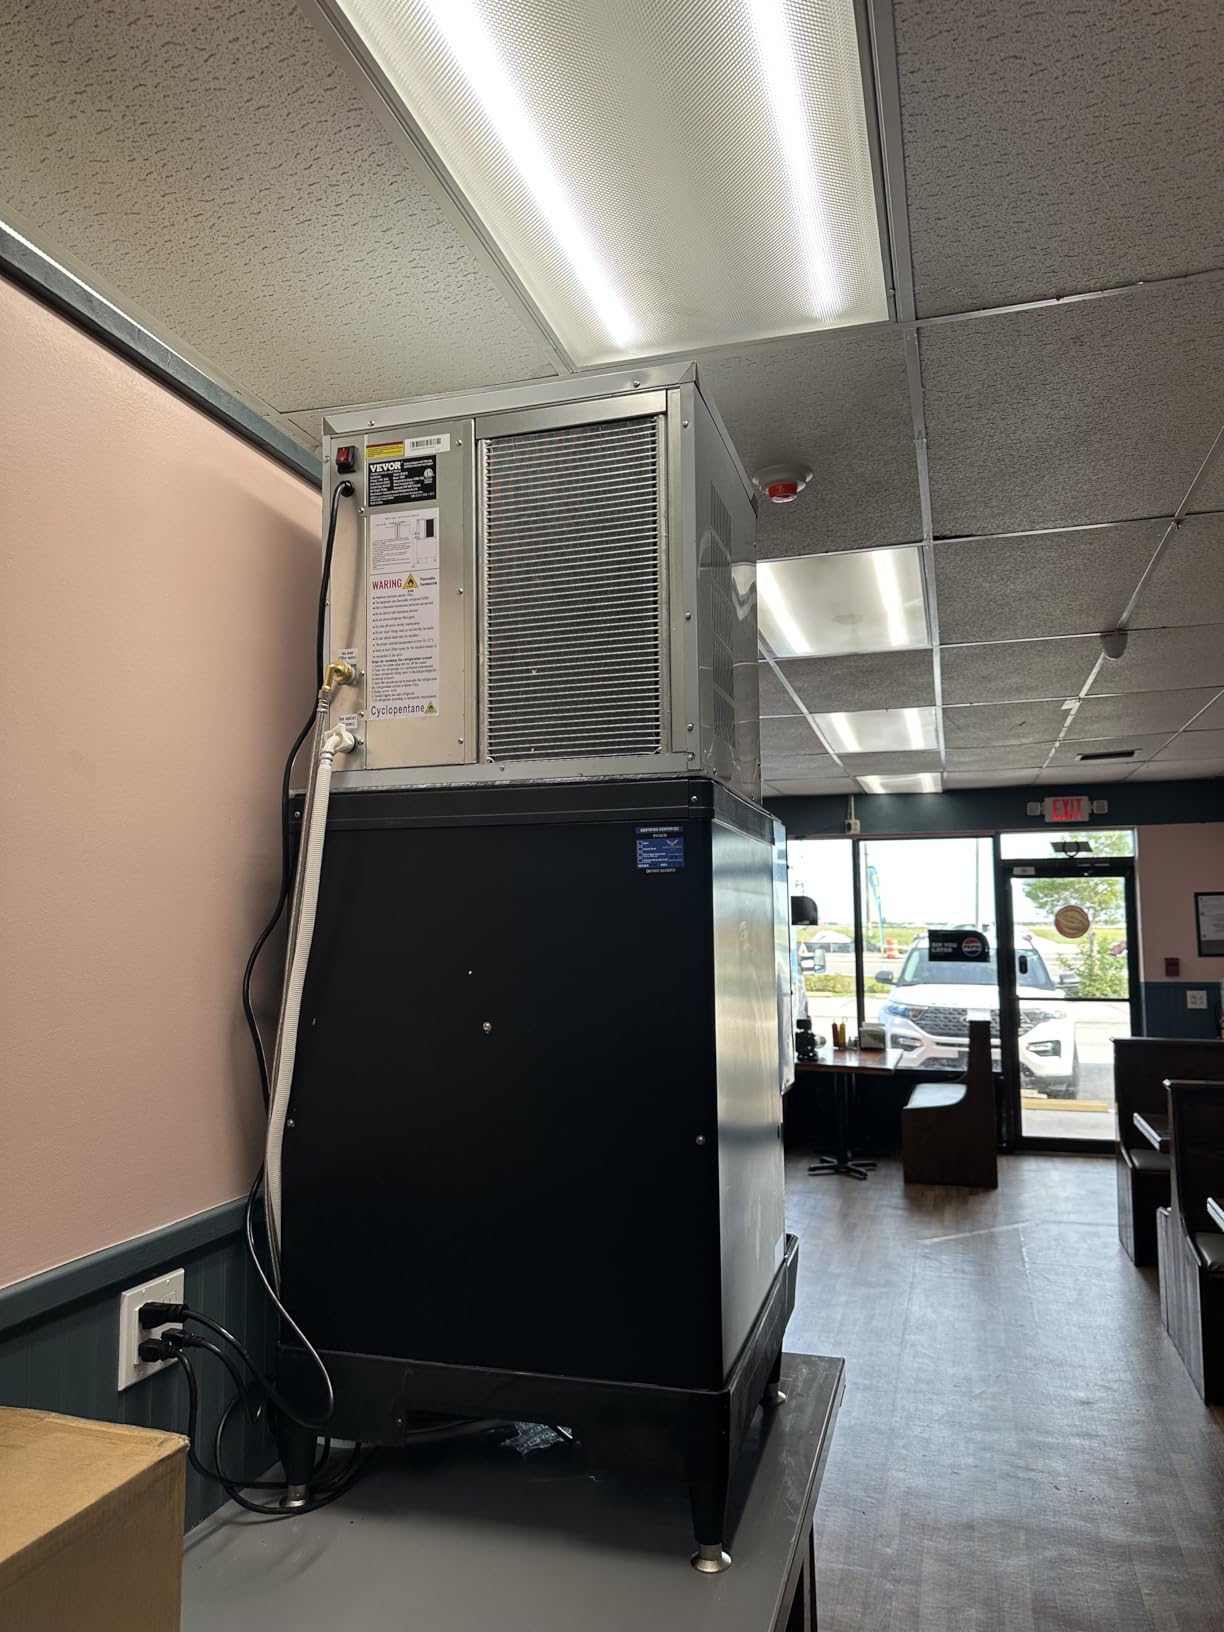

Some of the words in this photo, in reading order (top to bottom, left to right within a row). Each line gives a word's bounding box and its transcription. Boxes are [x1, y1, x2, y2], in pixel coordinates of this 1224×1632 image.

[370, 462, 401, 473] VEVOR
[372, 579, 402, 590] WARING
[371, 704, 424, 718] Cyclopentane
[1053, 799, 1082, 821] EXIT
